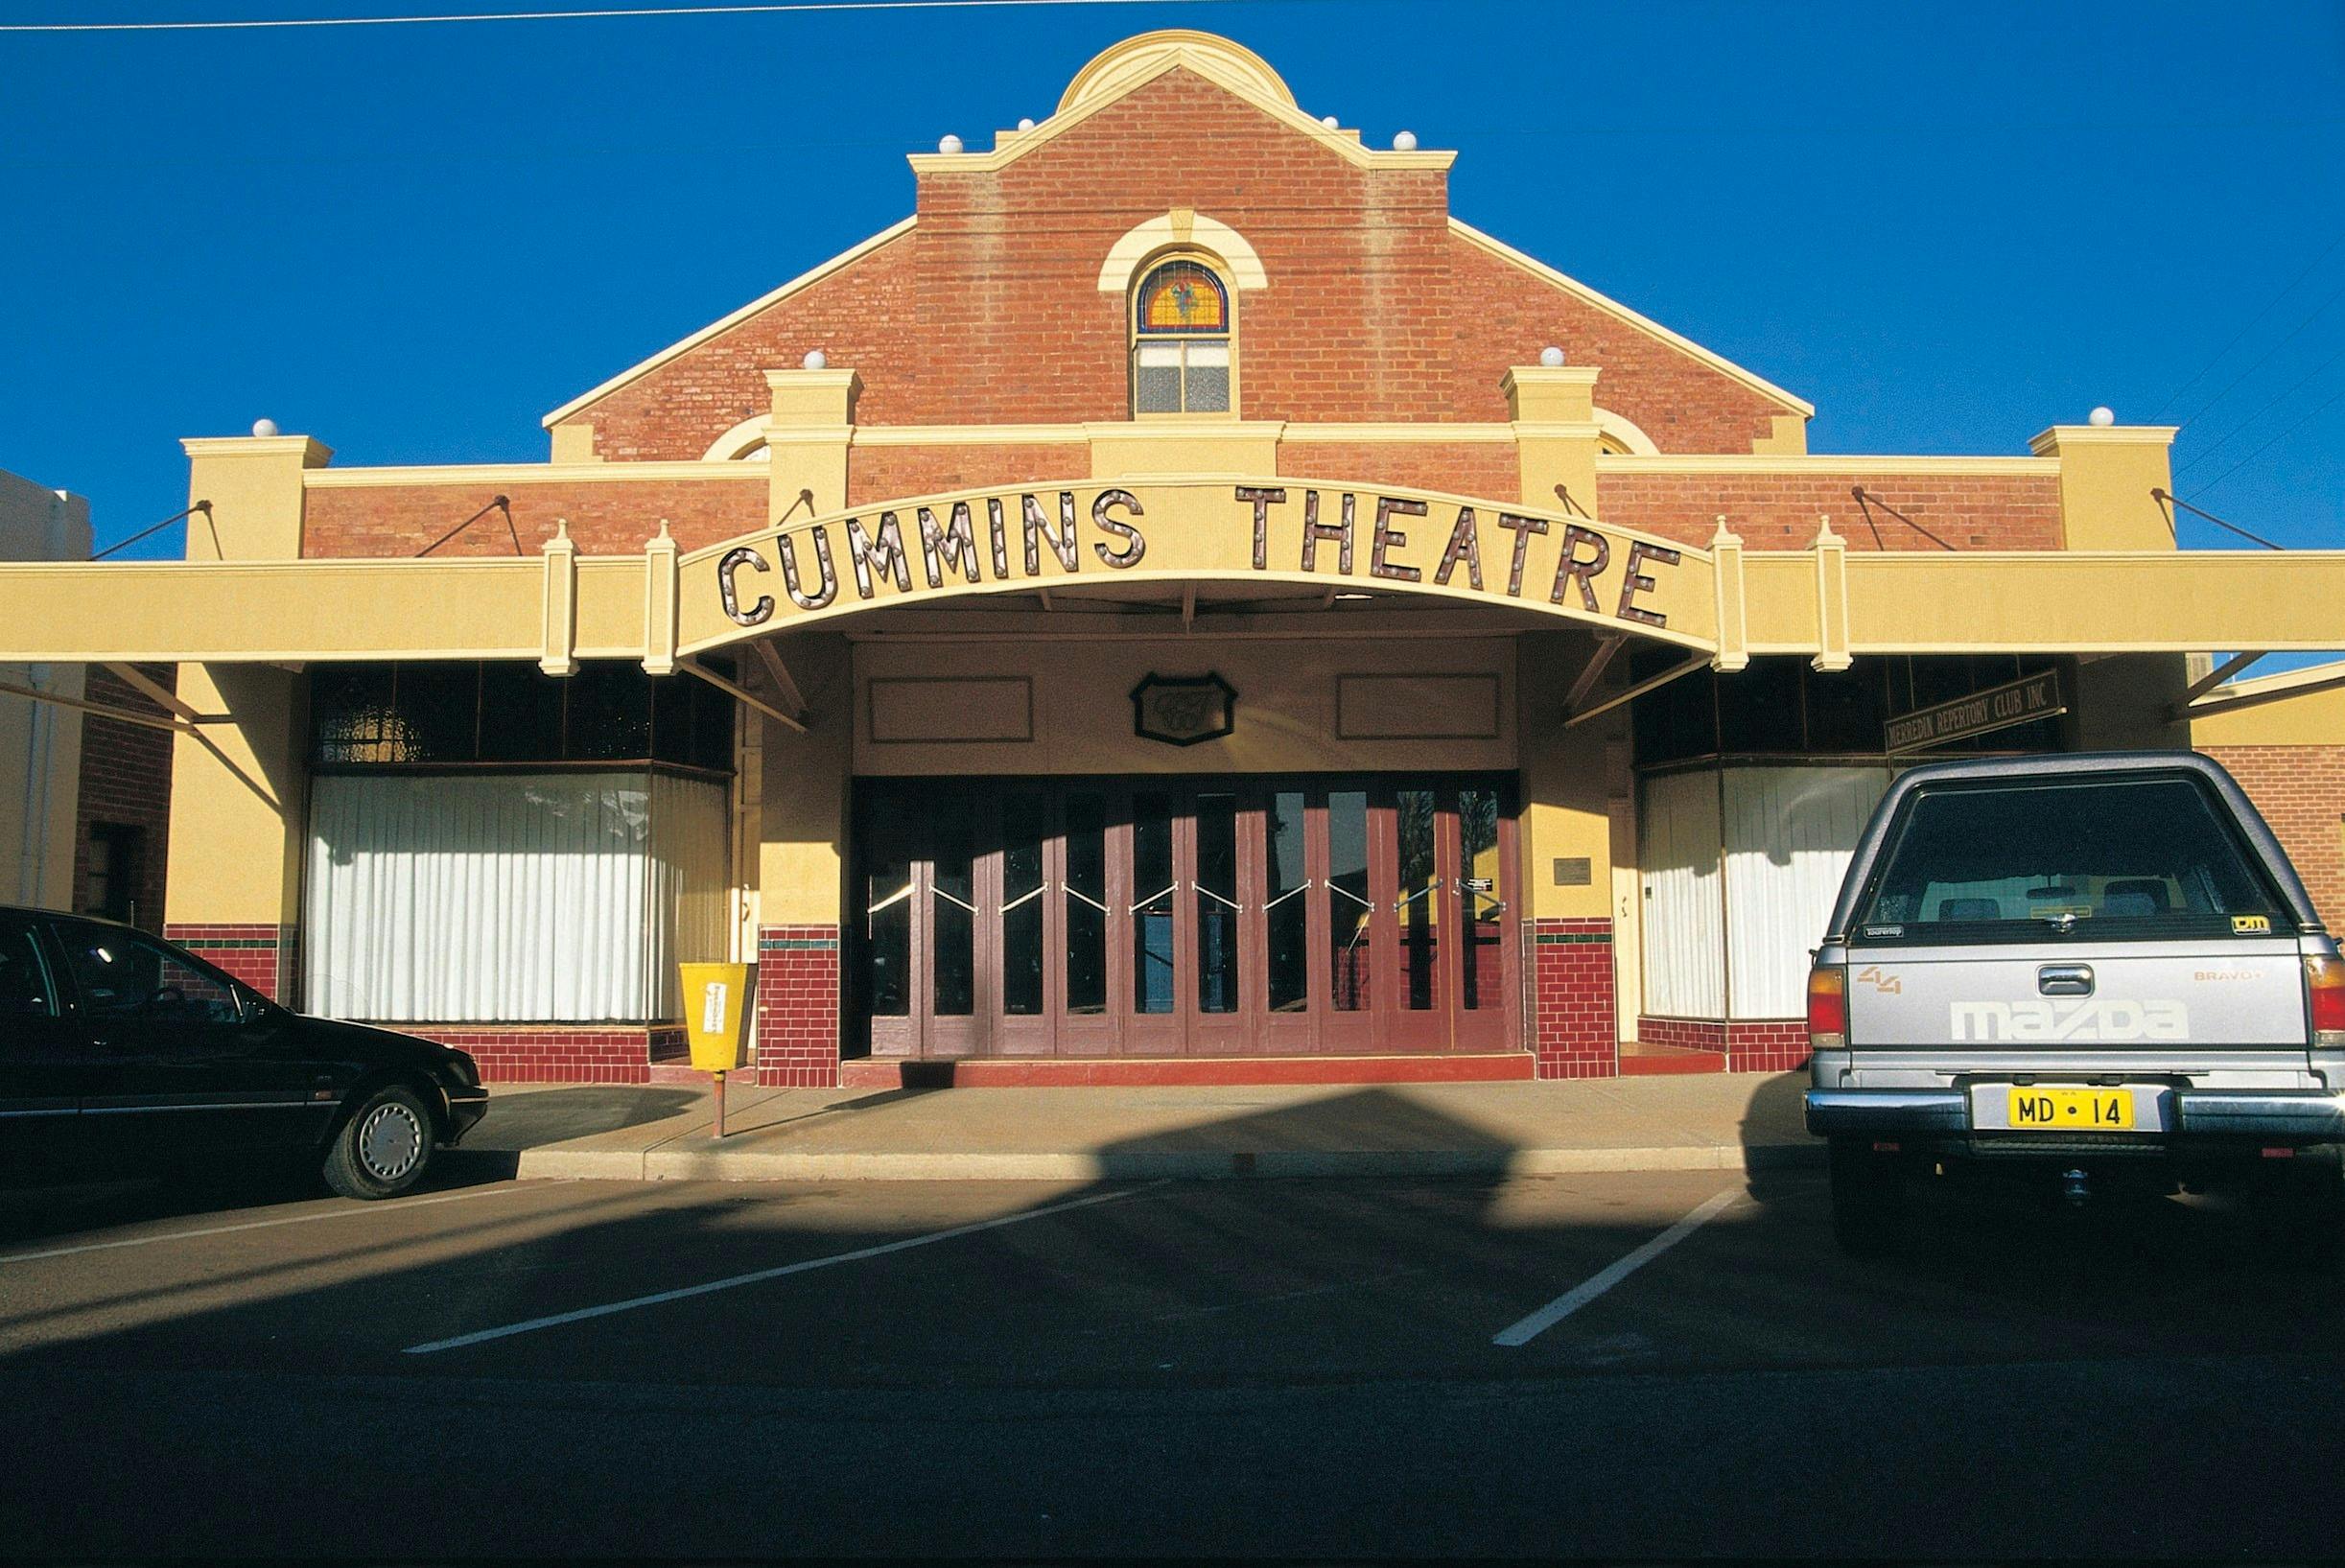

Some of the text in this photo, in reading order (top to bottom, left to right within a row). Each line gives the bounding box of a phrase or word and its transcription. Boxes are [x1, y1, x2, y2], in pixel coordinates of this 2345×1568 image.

[717, 485, 1680, 629] CUMMINS THEATRE
[1888, 682, 2047, 747] MERREDIN REPERTORY CLUB INC
